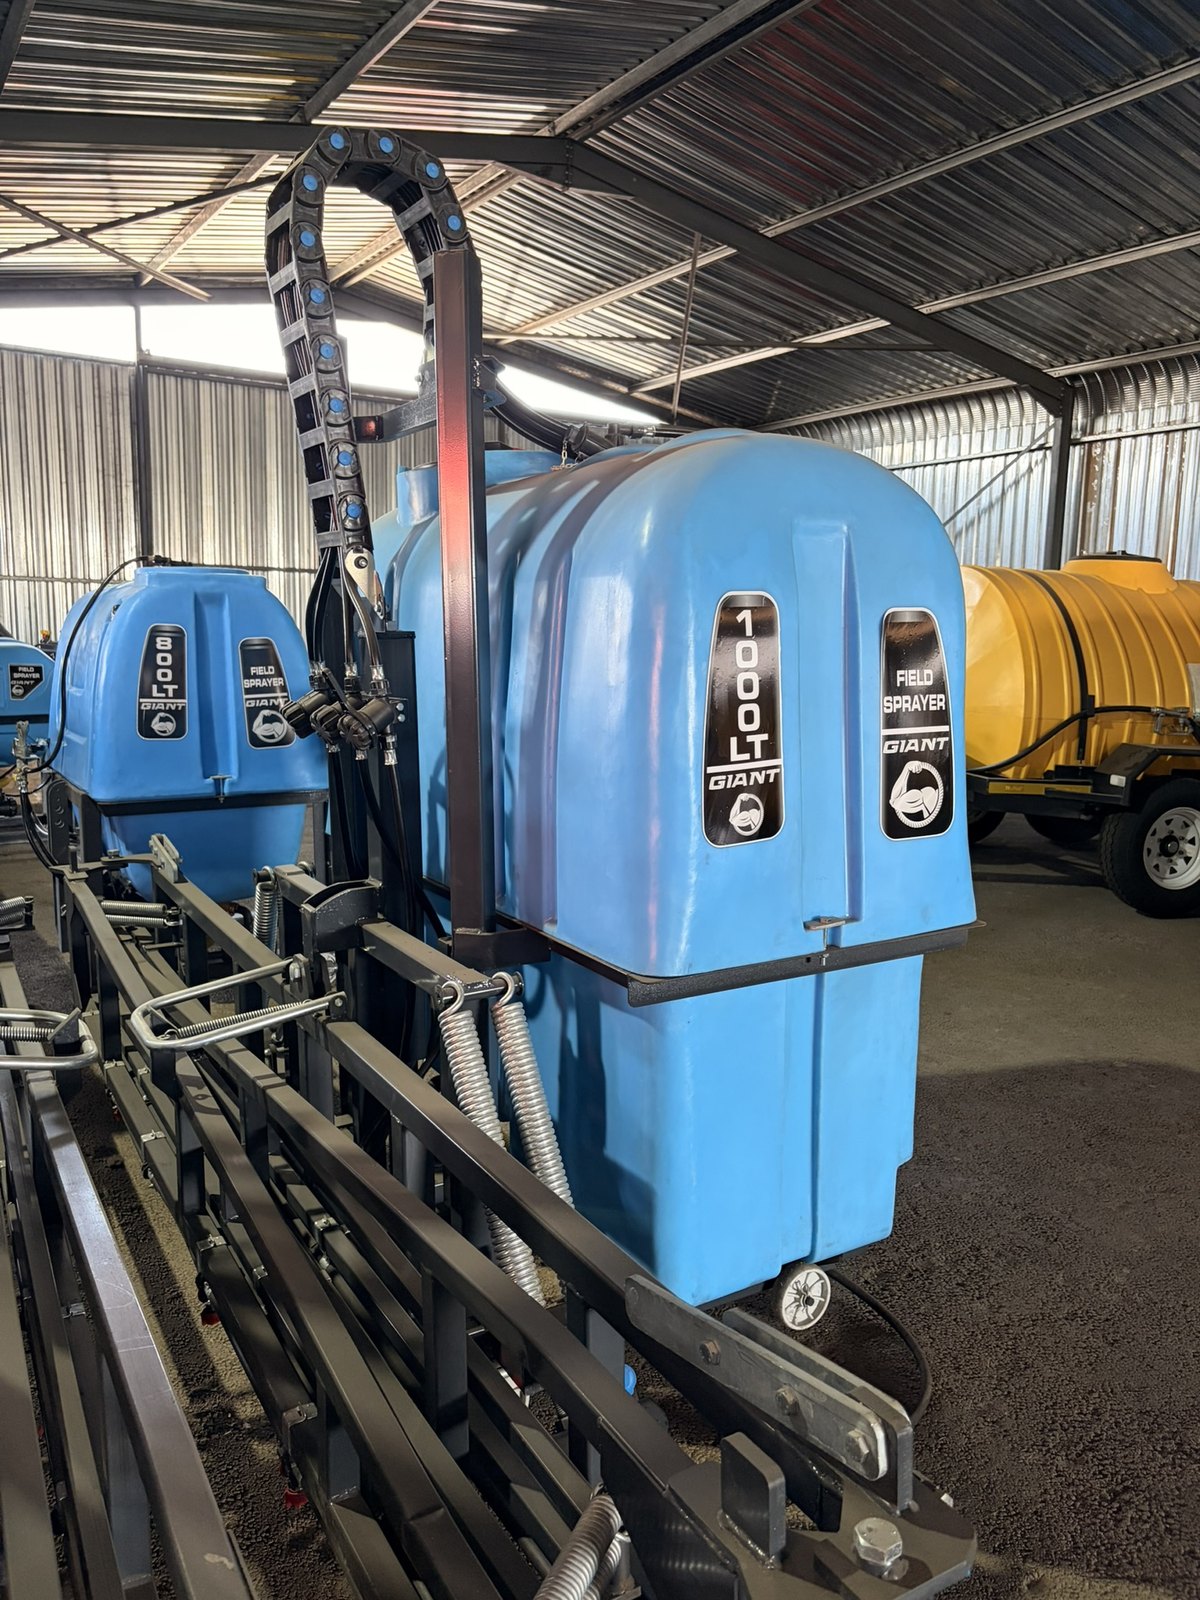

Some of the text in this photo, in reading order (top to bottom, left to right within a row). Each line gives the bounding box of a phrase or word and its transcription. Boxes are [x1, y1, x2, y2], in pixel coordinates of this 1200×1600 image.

[152, 637, 178, 698] 800 LT
[250, 665, 275, 676] FIELD
[243, 677, 285, 689] SPRAYER
[729, 609, 769, 762] 1000 LT
[896, 669, 934, 688] FIELD
[140, 702, 186, 711] GIANT
[245, 697, 289, 708] GIANT
[883, 693, 946, 714] SPRAYER
[882, 736, 949, 755] GIANT
[708, 768, 781, 791] GIANT
